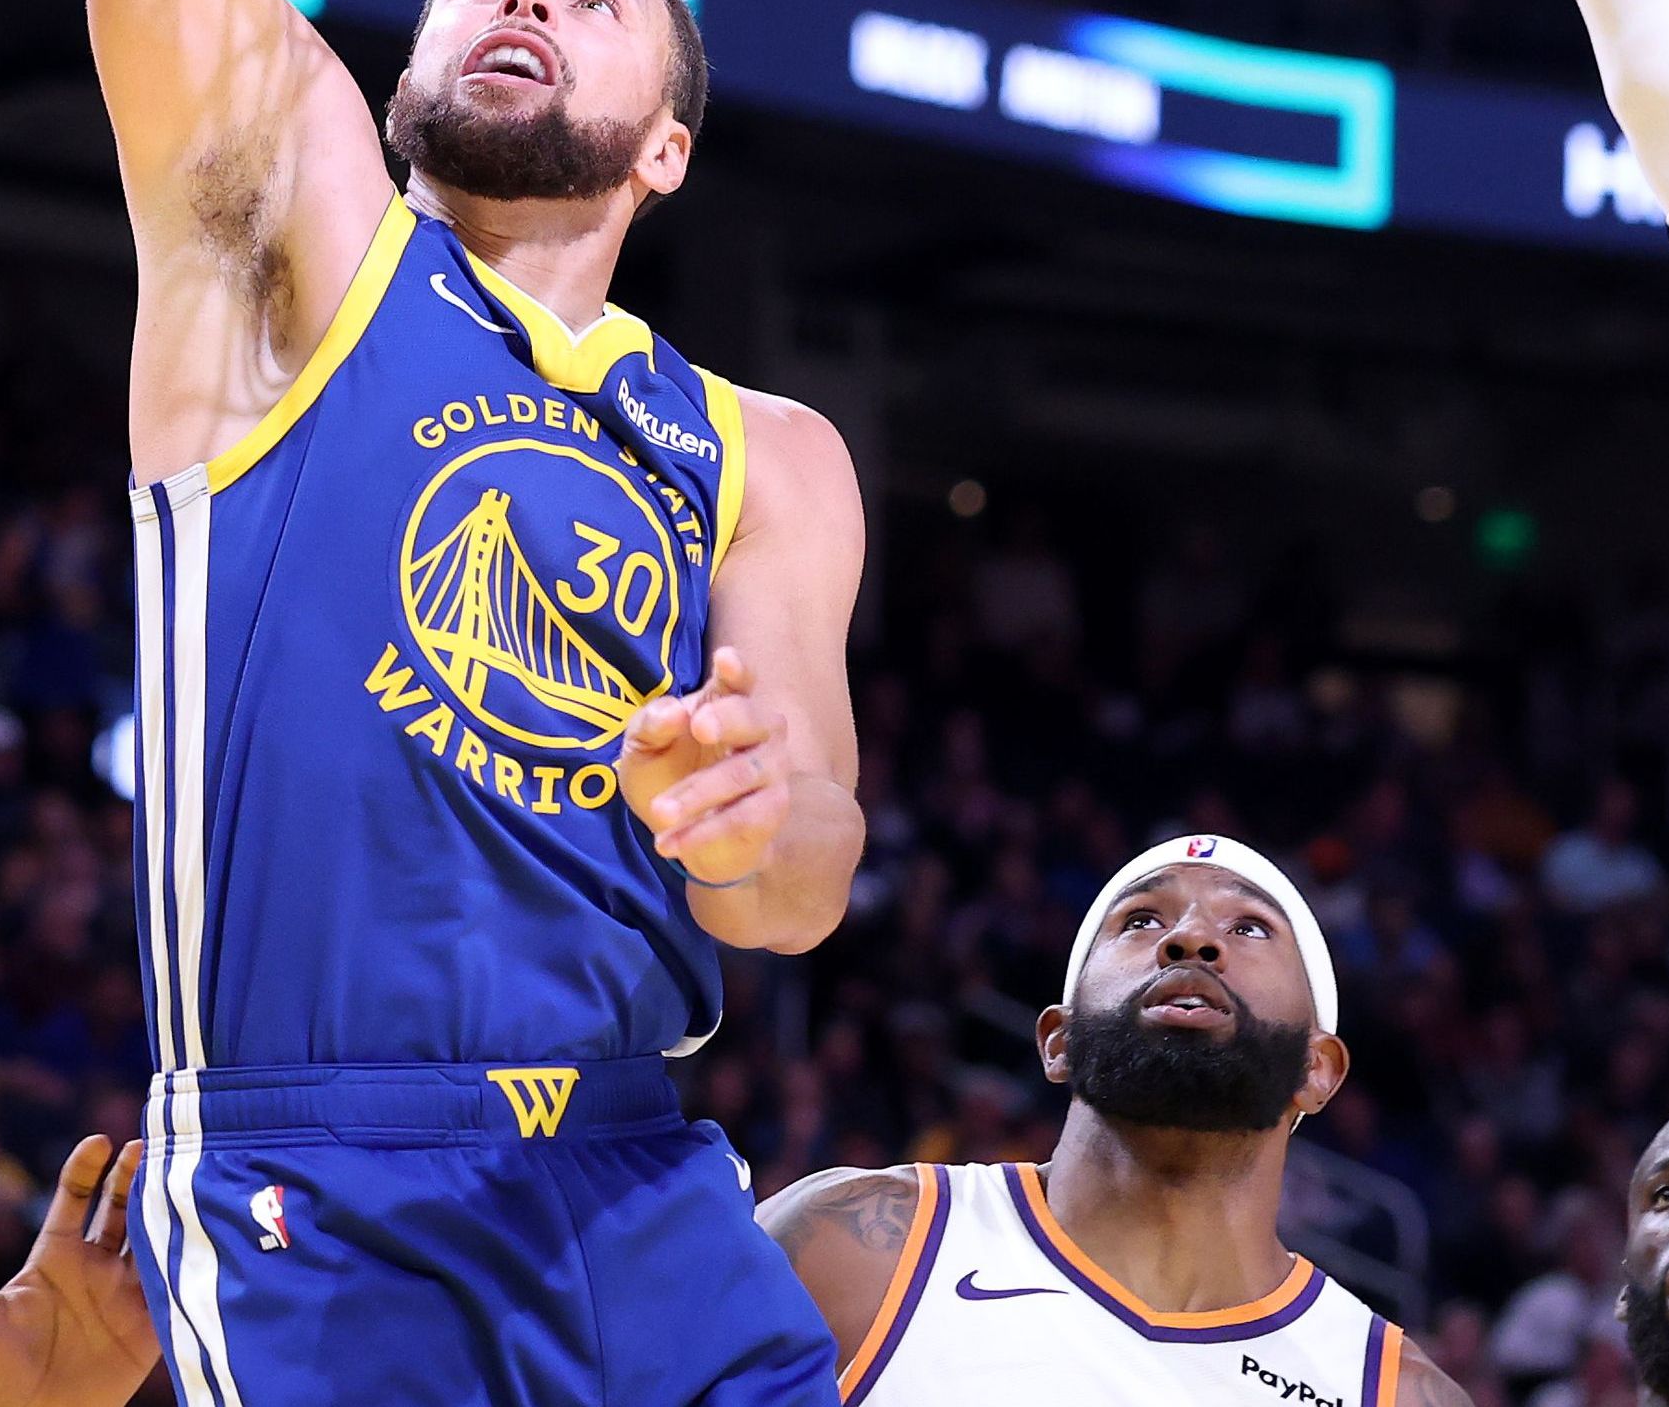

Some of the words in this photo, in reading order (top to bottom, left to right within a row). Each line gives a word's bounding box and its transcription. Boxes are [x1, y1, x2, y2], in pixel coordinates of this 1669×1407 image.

[412, 393, 600, 449] GOLDEN
[618, 446, 703, 567] SATE
[617, 377, 718, 463] Rakuten
[556, 521, 663, 636] 30
[363, 642, 621, 815] WARRIO
